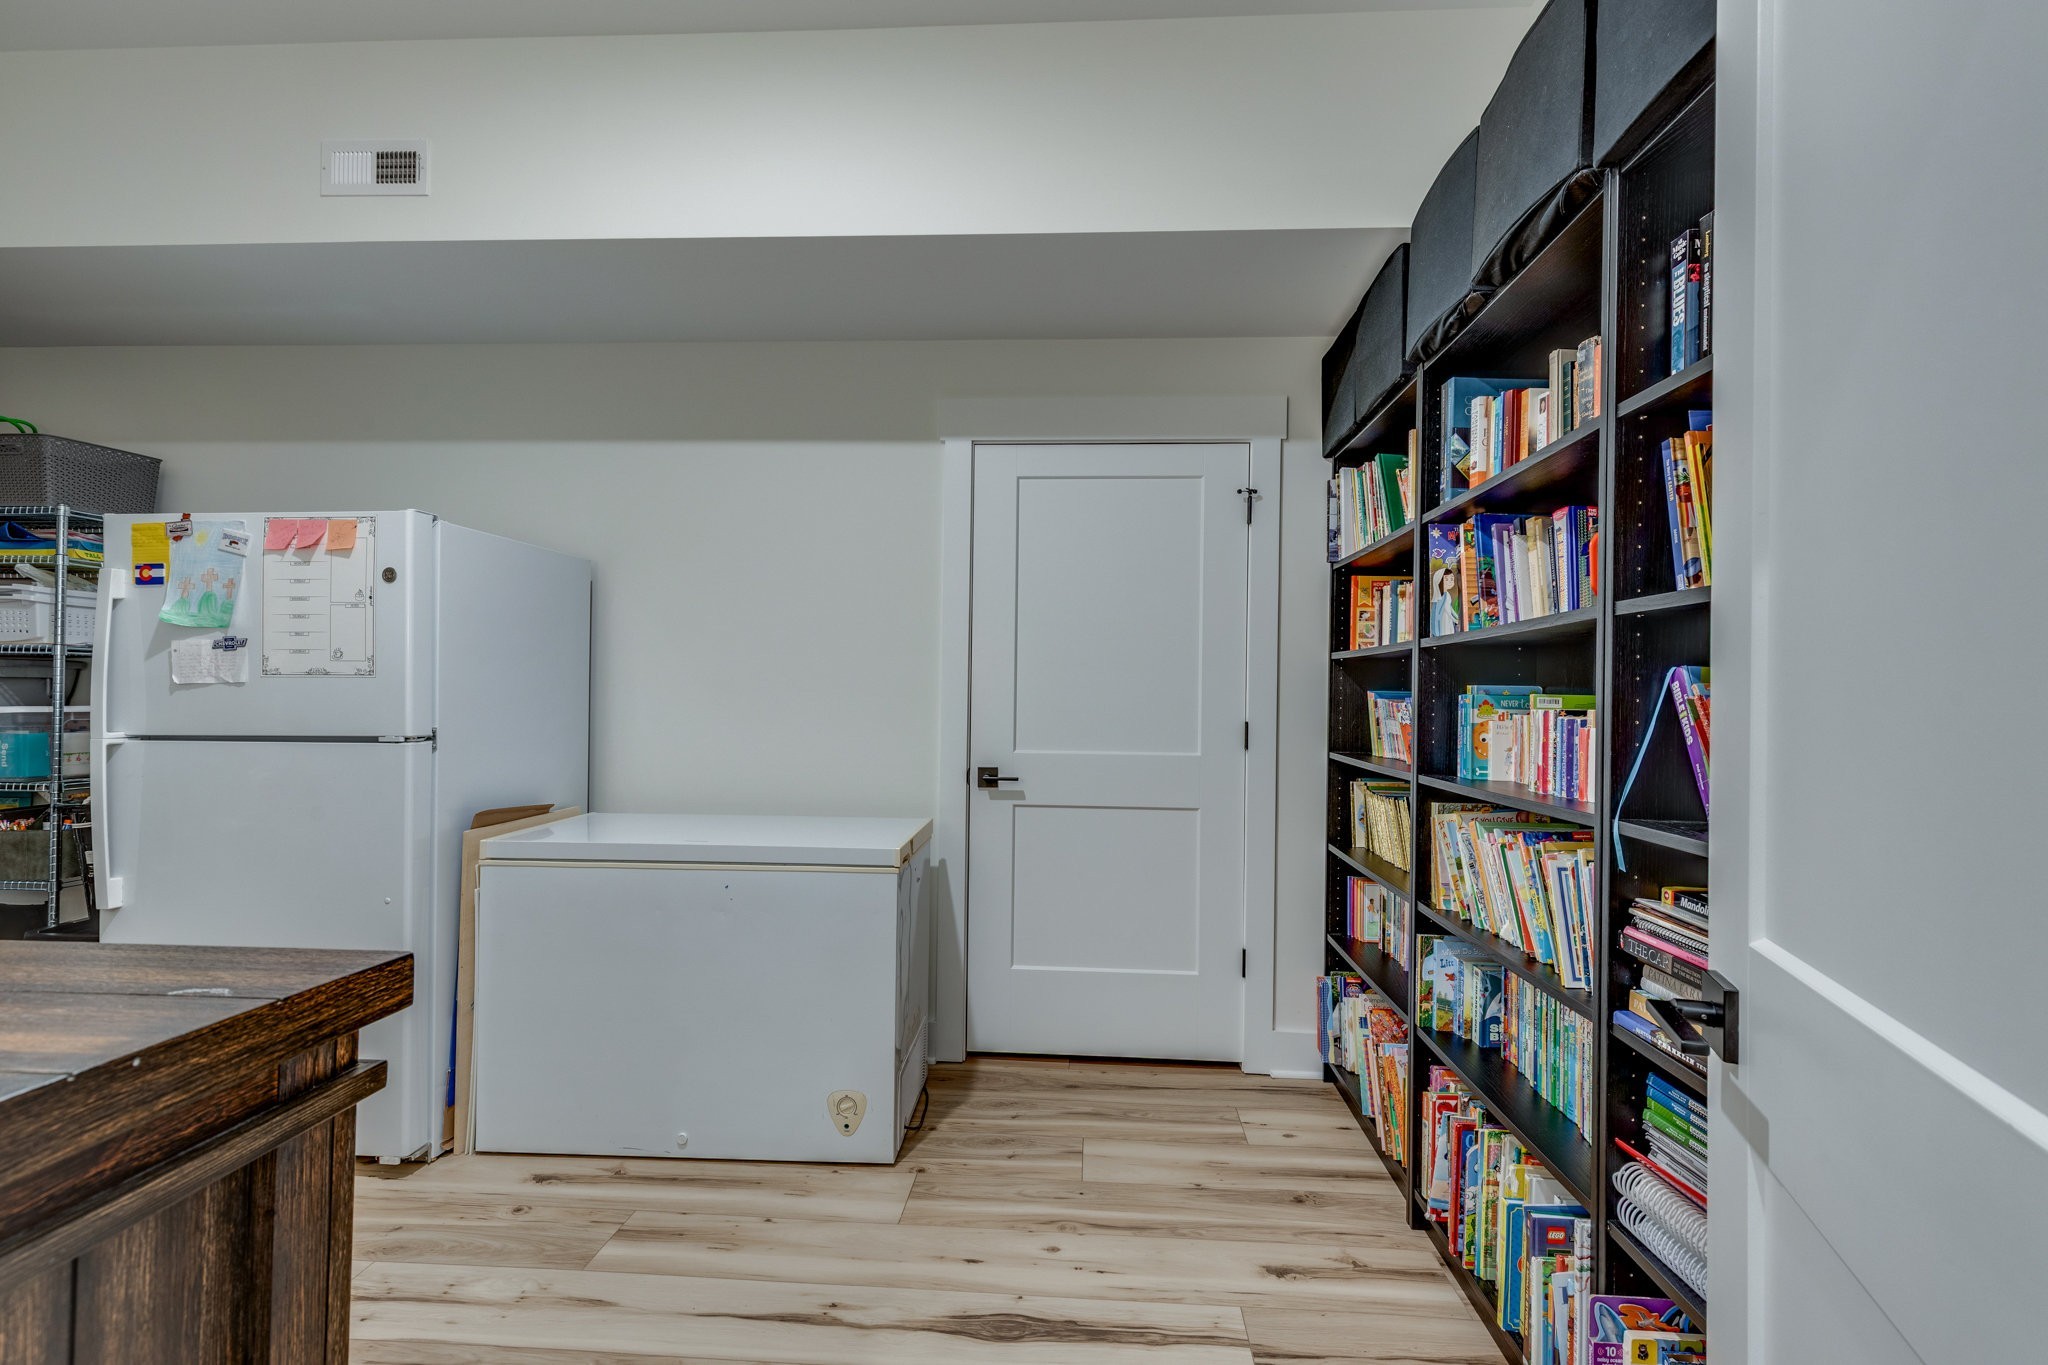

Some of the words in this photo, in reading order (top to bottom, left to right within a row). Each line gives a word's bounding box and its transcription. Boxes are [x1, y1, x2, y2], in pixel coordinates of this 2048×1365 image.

[1674, 267, 1685, 278] THE
[1673, 276, 1685, 327] BLUES
[1500, 700, 1519, 708] NEVER
[1671, 680, 1686, 712] BIBLE
[1679, 718, 1693, 746] KIDS
[1, 743, 9, 767] Send
[1628, 938, 1648, 960] THE
[1648, 967, 1677, 989] PATINA
[1657, 1039, 1695, 1065] FRANKLIN
[1547, 1231, 1565, 1240] LEGO
[1605, 1346, 1616, 1357] 10
